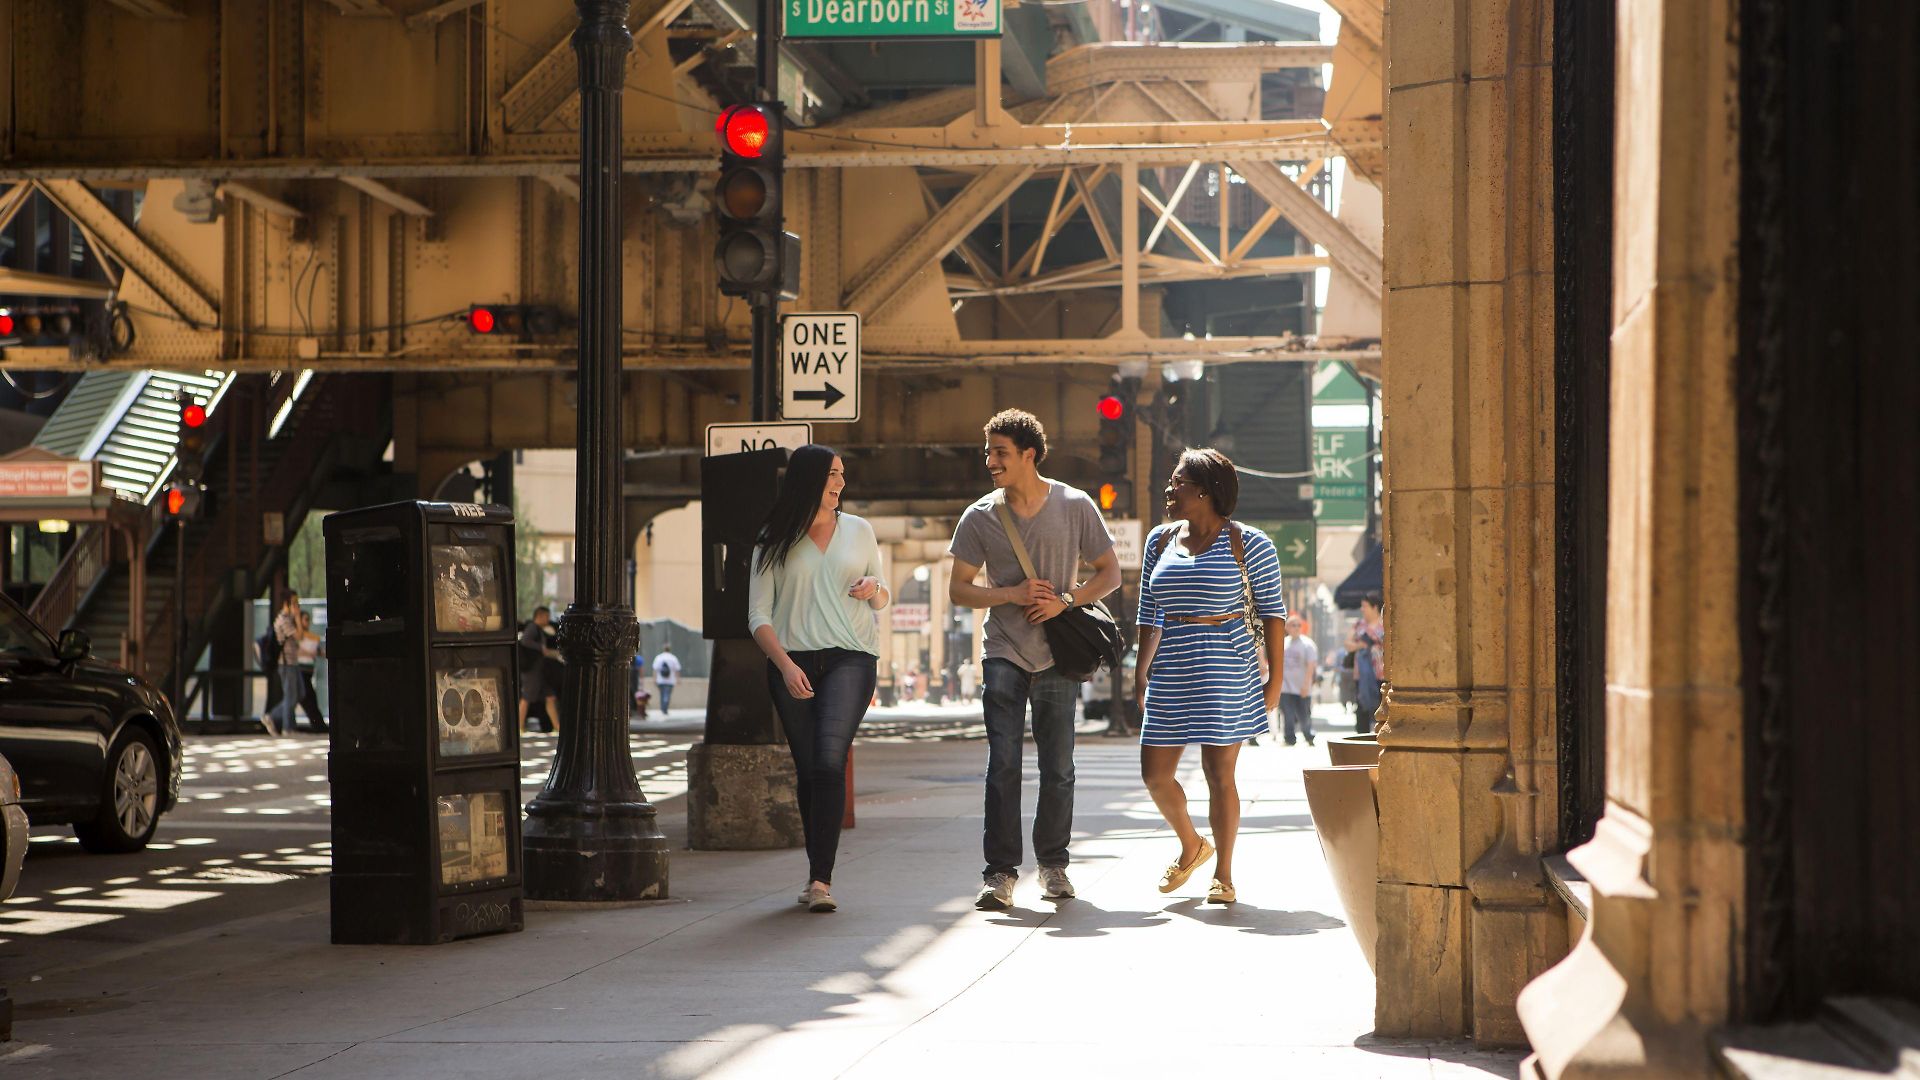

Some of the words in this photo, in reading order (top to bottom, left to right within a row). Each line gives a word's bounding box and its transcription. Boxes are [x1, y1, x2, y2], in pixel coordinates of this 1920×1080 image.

[792, 1, 800, 16] S
[808, 0, 928, 23] Dearborn
[934, 0, 948, 15] St
[793, 323, 846, 346] ONE
[791, 352, 848, 374] WAY
[450, 503, 486, 517] FREE
[1115, 540, 1131, 549] RN
